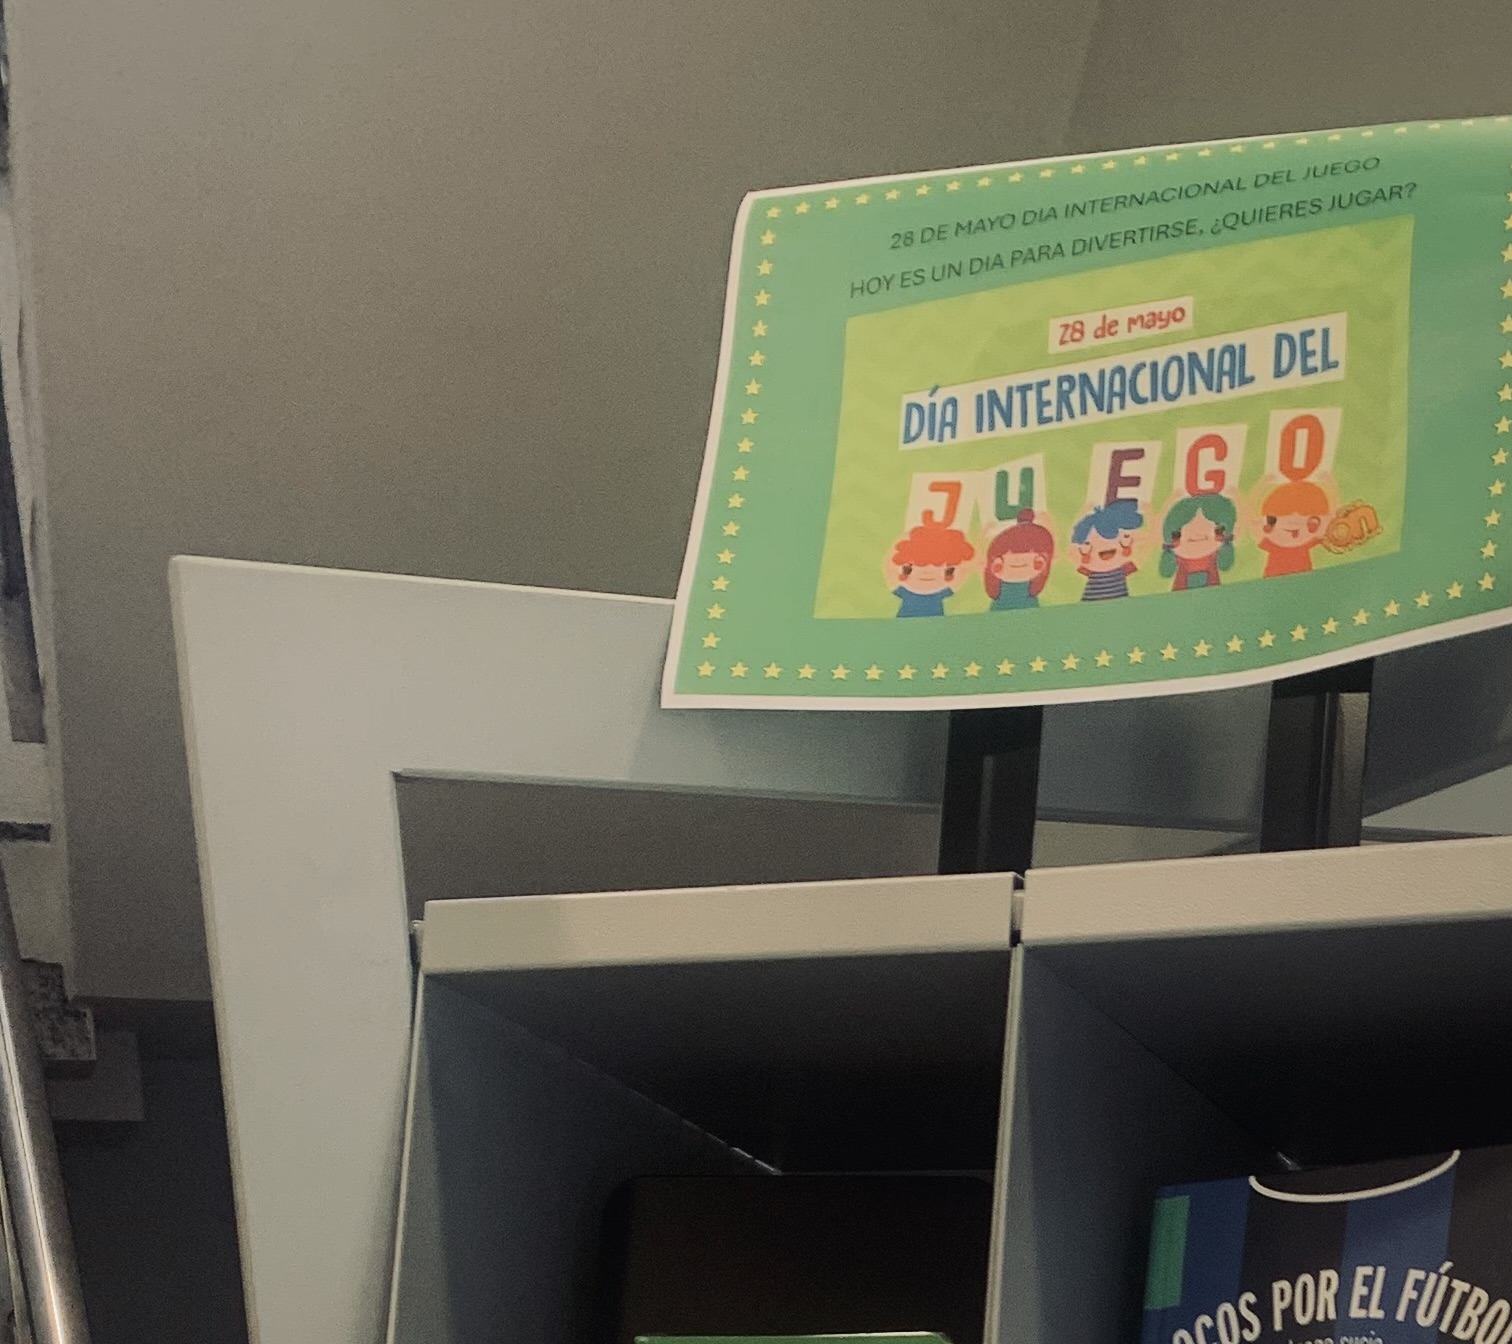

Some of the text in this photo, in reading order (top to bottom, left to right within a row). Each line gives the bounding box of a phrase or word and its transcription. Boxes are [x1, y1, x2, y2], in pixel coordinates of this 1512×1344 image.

[850, 272, 896, 299] HOY
[900, 267, 926, 289] ES
[930, 261, 963, 283] UN
[968, 252, 1005, 276] DIA
[1009, 242, 1066, 268] PARA
[1209, 197, 1323, 236] ¿QUIERES
[1327, 181, 1418, 213] JUGAR?
[890, 156, 1381, 250] 28 DE MAYO DIA INTERNACIONAL DEL JUEGO
[1058, 305, 1186, 346] 28 de mayo
[902, 326, 1340, 446] DÍA INTERNACIONAL DEL
[1271, 1268, 1340, 1332] POR
[1348, 1265, 1387, 1320] EL
